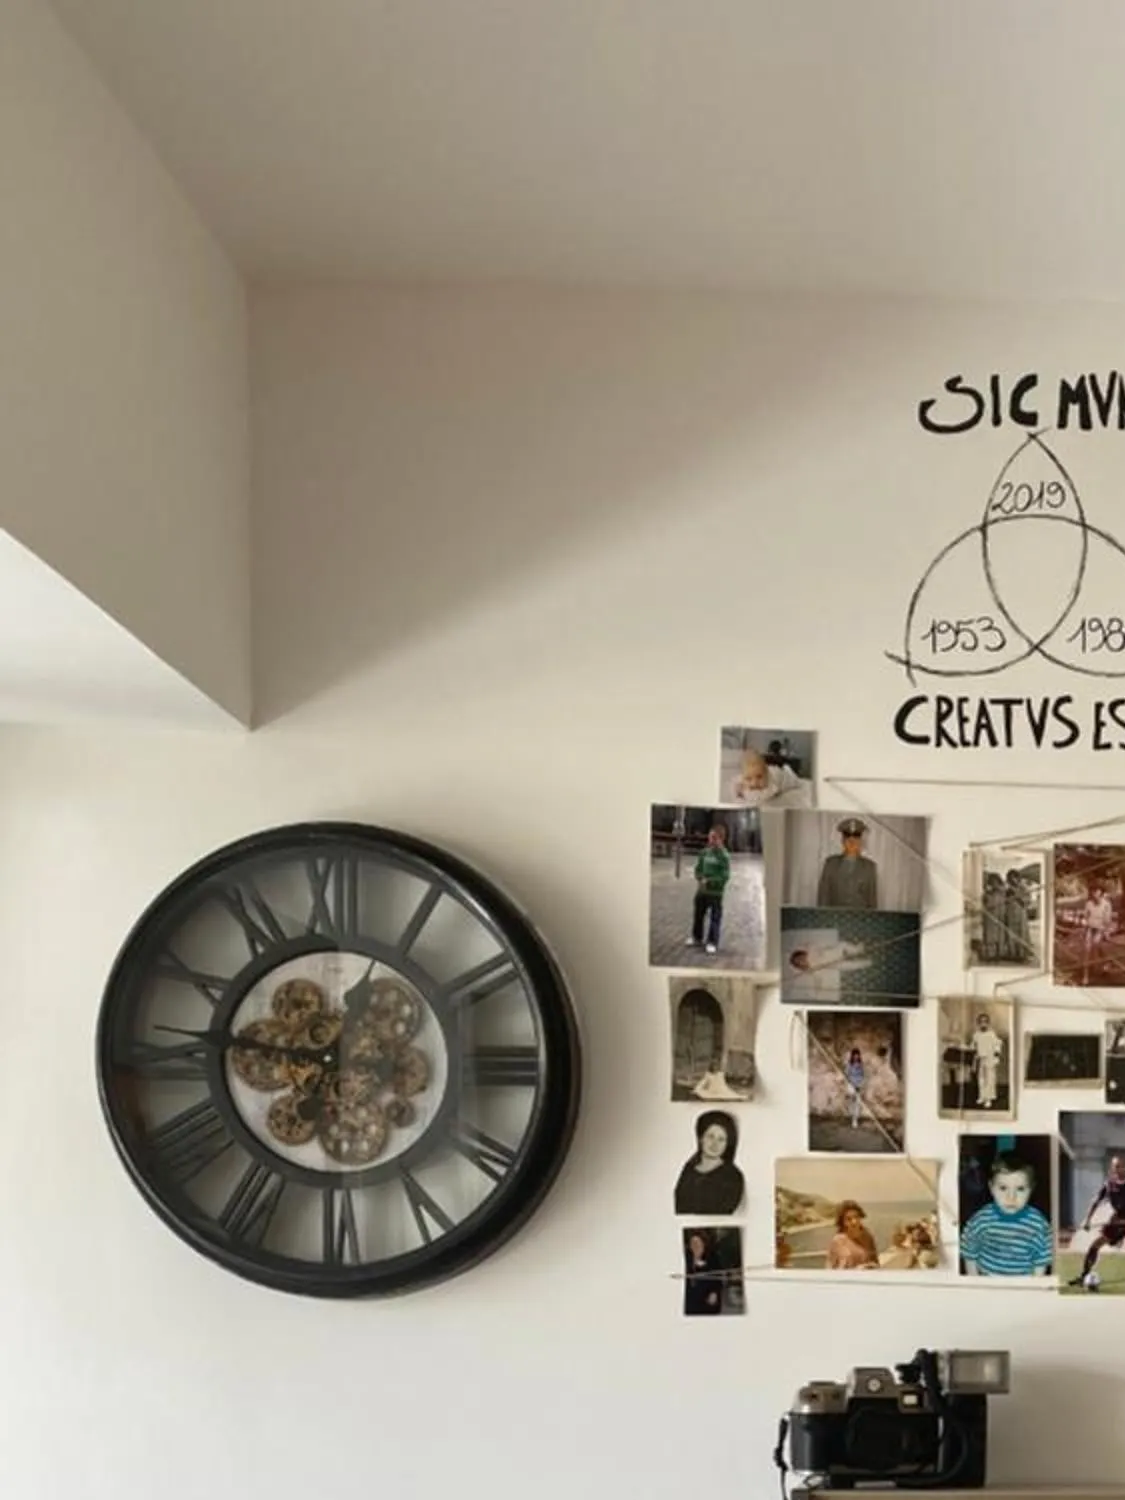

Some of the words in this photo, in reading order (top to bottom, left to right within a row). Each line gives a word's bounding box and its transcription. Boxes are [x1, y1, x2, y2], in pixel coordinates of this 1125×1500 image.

[918, 373, 1039, 434] SIC
[991, 480, 1067, 514] 2019
[921, 615, 1007, 654] 1953
